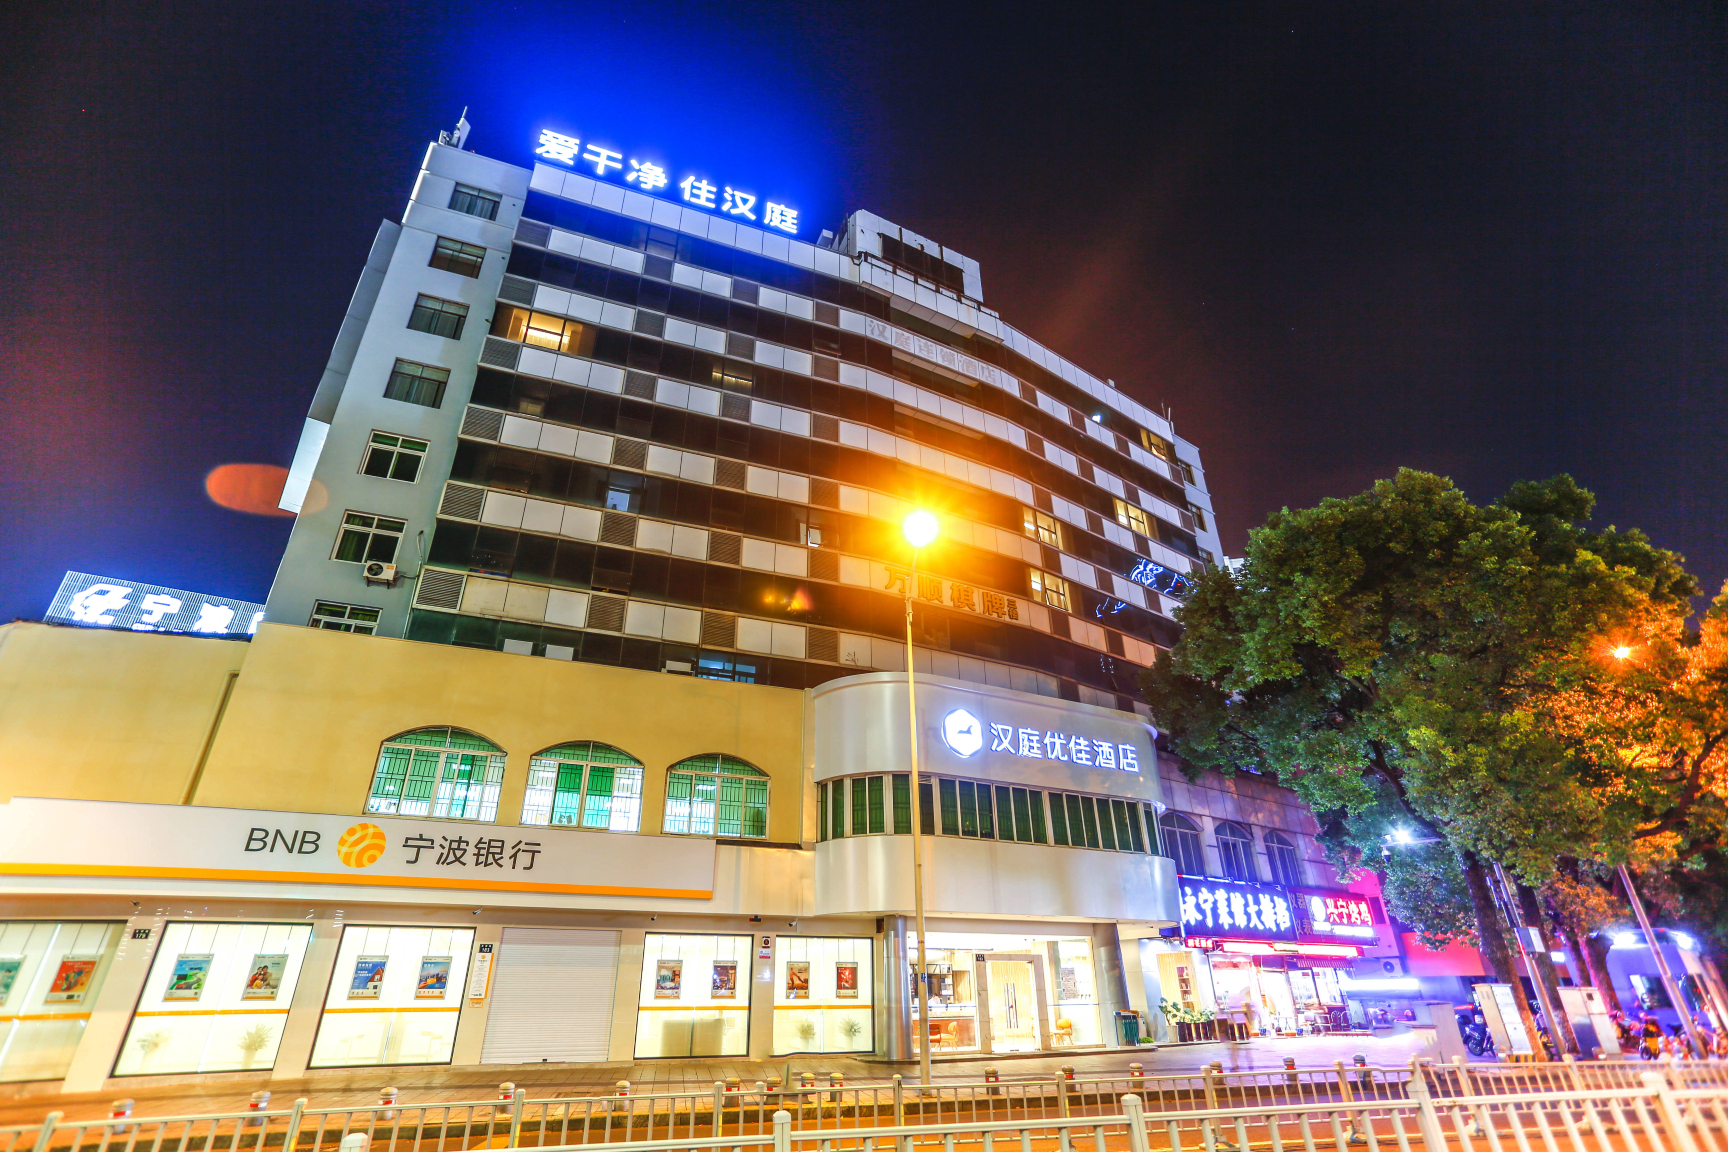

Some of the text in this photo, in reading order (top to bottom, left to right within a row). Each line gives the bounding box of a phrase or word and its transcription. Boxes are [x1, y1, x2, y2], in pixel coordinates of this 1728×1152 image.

[535, 129, 798, 234] 爱干净 住汉庭
[868, 319, 997, 384] 汉庭连锁酒店
[885, 566, 1007, 618] 万顺棋牌
[990, 722, 1140, 773] 汉庭优佳酒店
[244, 827, 321, 855] BNB
[402, 833, 542, 870] 宁波银行
